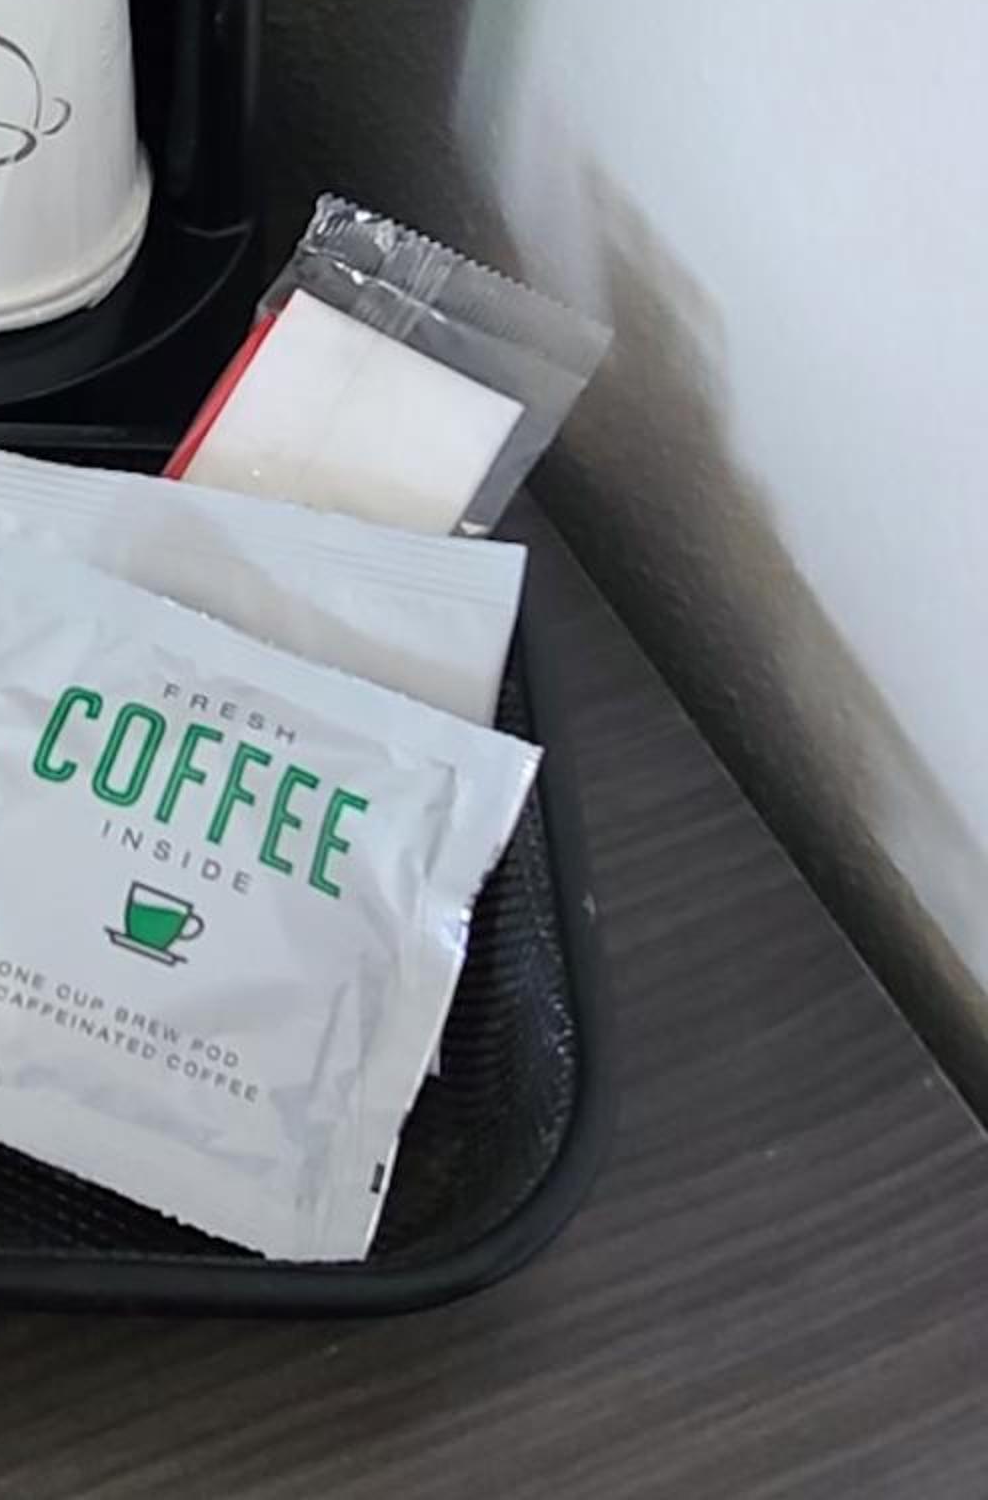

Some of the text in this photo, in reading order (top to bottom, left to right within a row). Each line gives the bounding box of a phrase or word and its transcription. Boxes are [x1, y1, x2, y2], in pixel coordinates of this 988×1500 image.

[164, 682, 298, 744] FRESH
[32, 685, 369, 899] COFFEE
[101, 819, 252, 895] INSIDE
[56, 983, 105, 1011] CUP
[114, 1006, 181, 1045] BREW
[190, 1037, 239, 1069] POD
[166, 1052, 259, 1103] COFFEE
